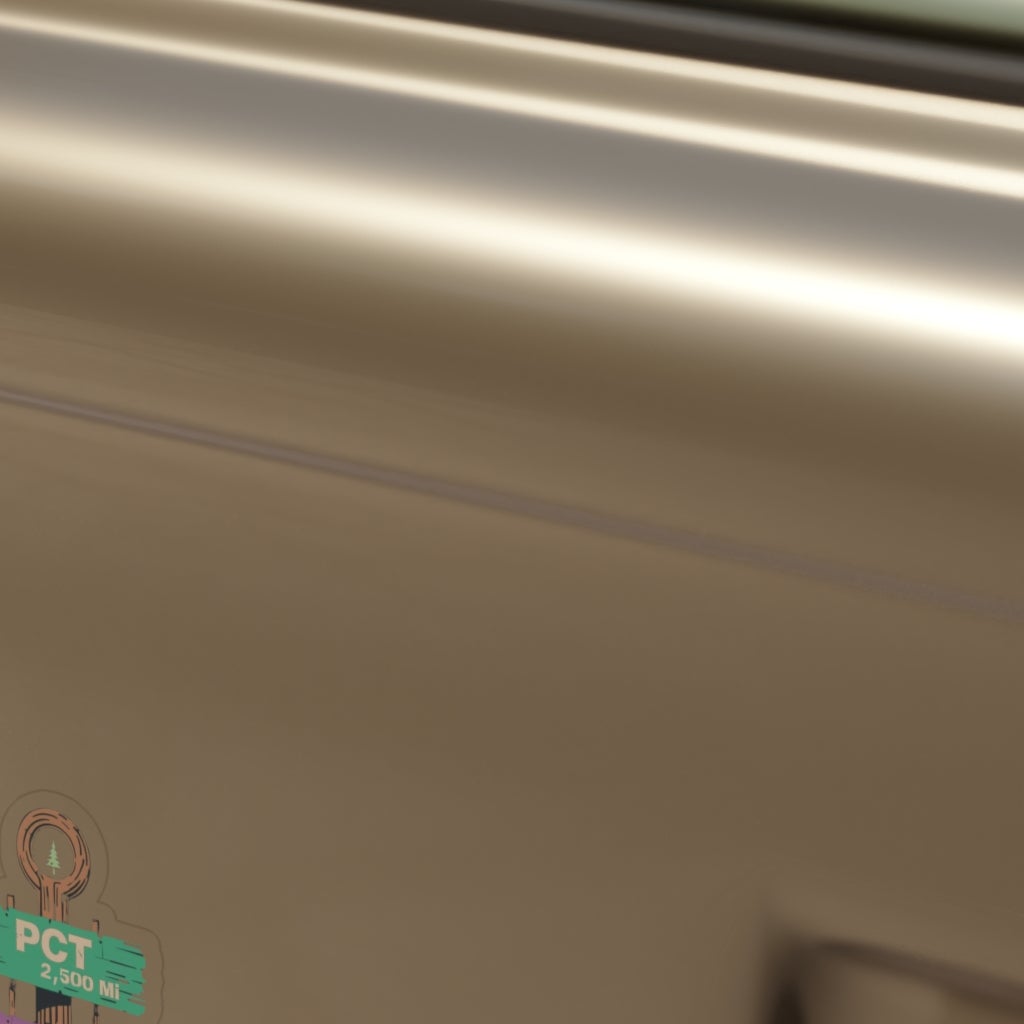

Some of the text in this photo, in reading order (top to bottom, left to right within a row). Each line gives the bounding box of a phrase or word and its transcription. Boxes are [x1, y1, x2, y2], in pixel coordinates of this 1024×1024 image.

[15, 918, 93, 970] PCT
[40, 962, 120, 1001] 2,500 Mi
